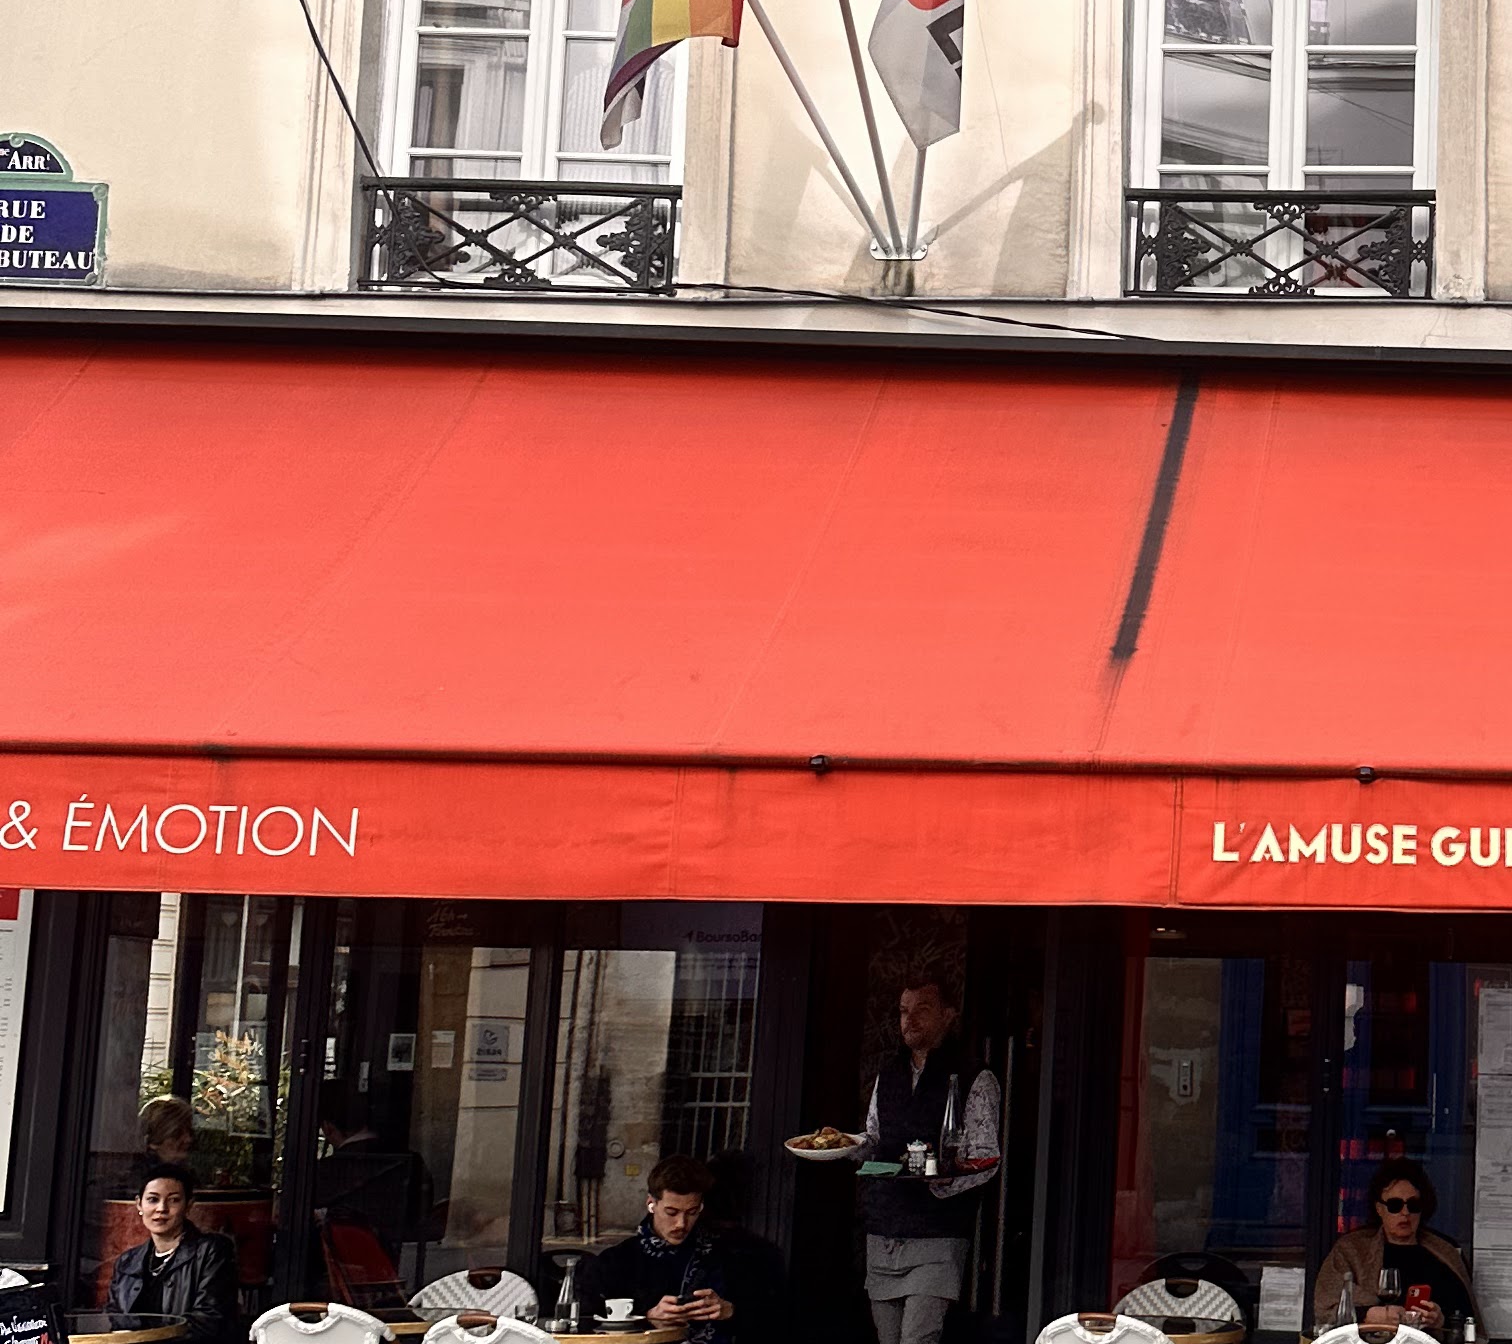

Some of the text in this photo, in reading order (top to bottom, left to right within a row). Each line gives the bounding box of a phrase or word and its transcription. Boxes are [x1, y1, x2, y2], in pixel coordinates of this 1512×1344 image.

[1, 225, 34, 244] DE
[0, 793, 359, 857] & ÉMOTION
[1212, 821, 1417, 865] L'AMUSE
